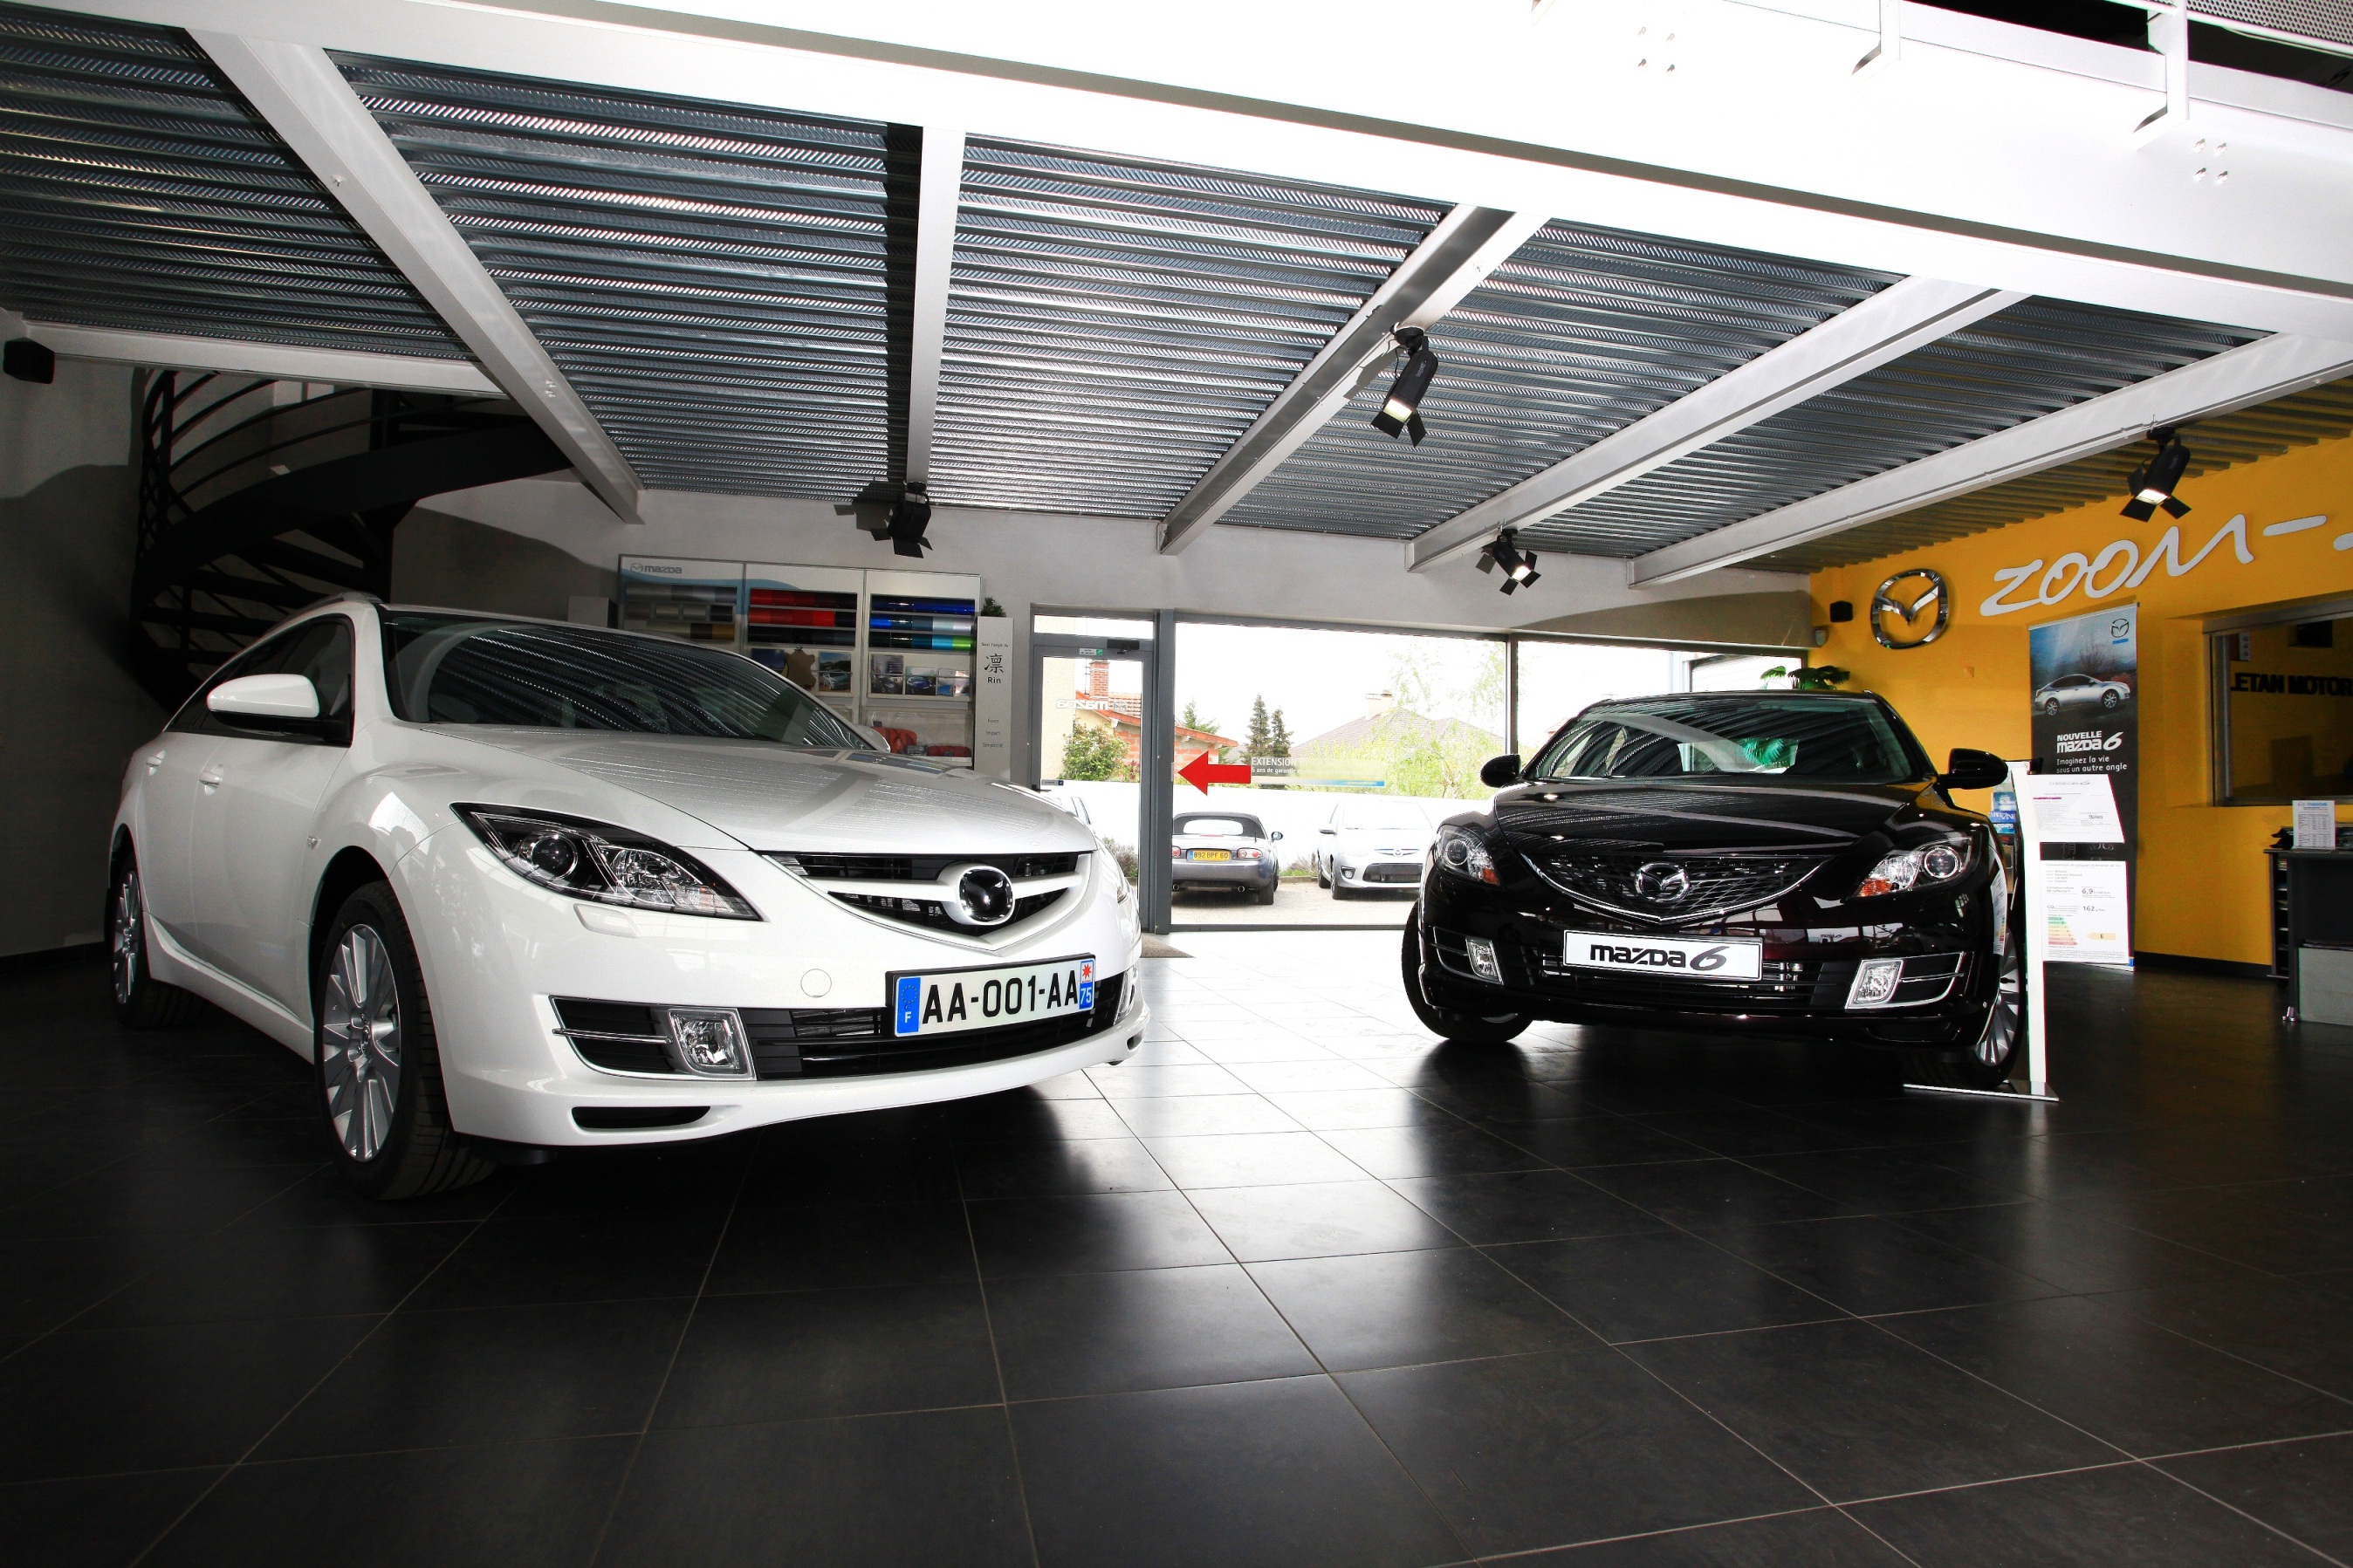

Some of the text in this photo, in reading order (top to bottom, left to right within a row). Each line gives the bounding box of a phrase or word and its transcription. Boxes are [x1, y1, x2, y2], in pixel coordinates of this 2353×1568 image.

[2056, 730, 2103, 742] NOUVELLE
[2056, 757, 2087, 767] Imaginez
[2089, 755, 2096, 763] la
[2105, 763, 2128, 772] angle
[904, 969, 1092, 1024] F AA-001-AA 75
